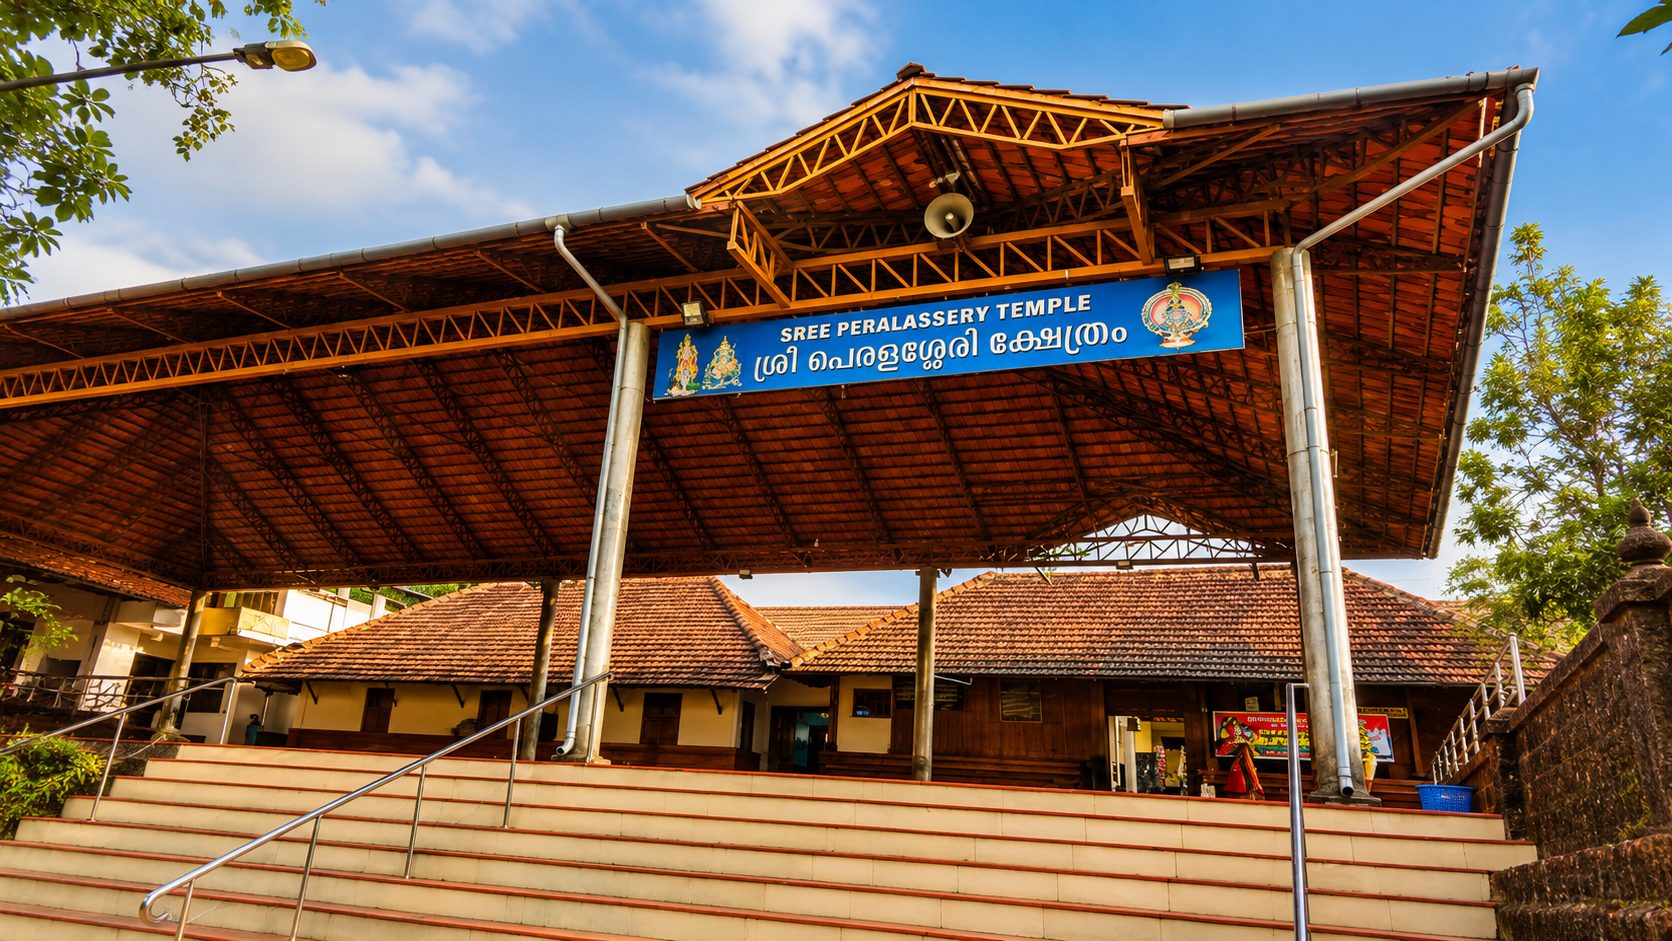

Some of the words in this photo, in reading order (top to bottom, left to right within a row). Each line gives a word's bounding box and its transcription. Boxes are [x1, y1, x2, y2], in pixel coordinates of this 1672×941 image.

[780, 323, 831, 343] SREE
[837, 304, 990, 337] PERALASSERY
[996, 294, 1091, 320] TEMPLE
[808, 327, 978, 372] പെരളശ്ശേരി
[989, 321, 1128, 355] ക്ഷേത്രം
